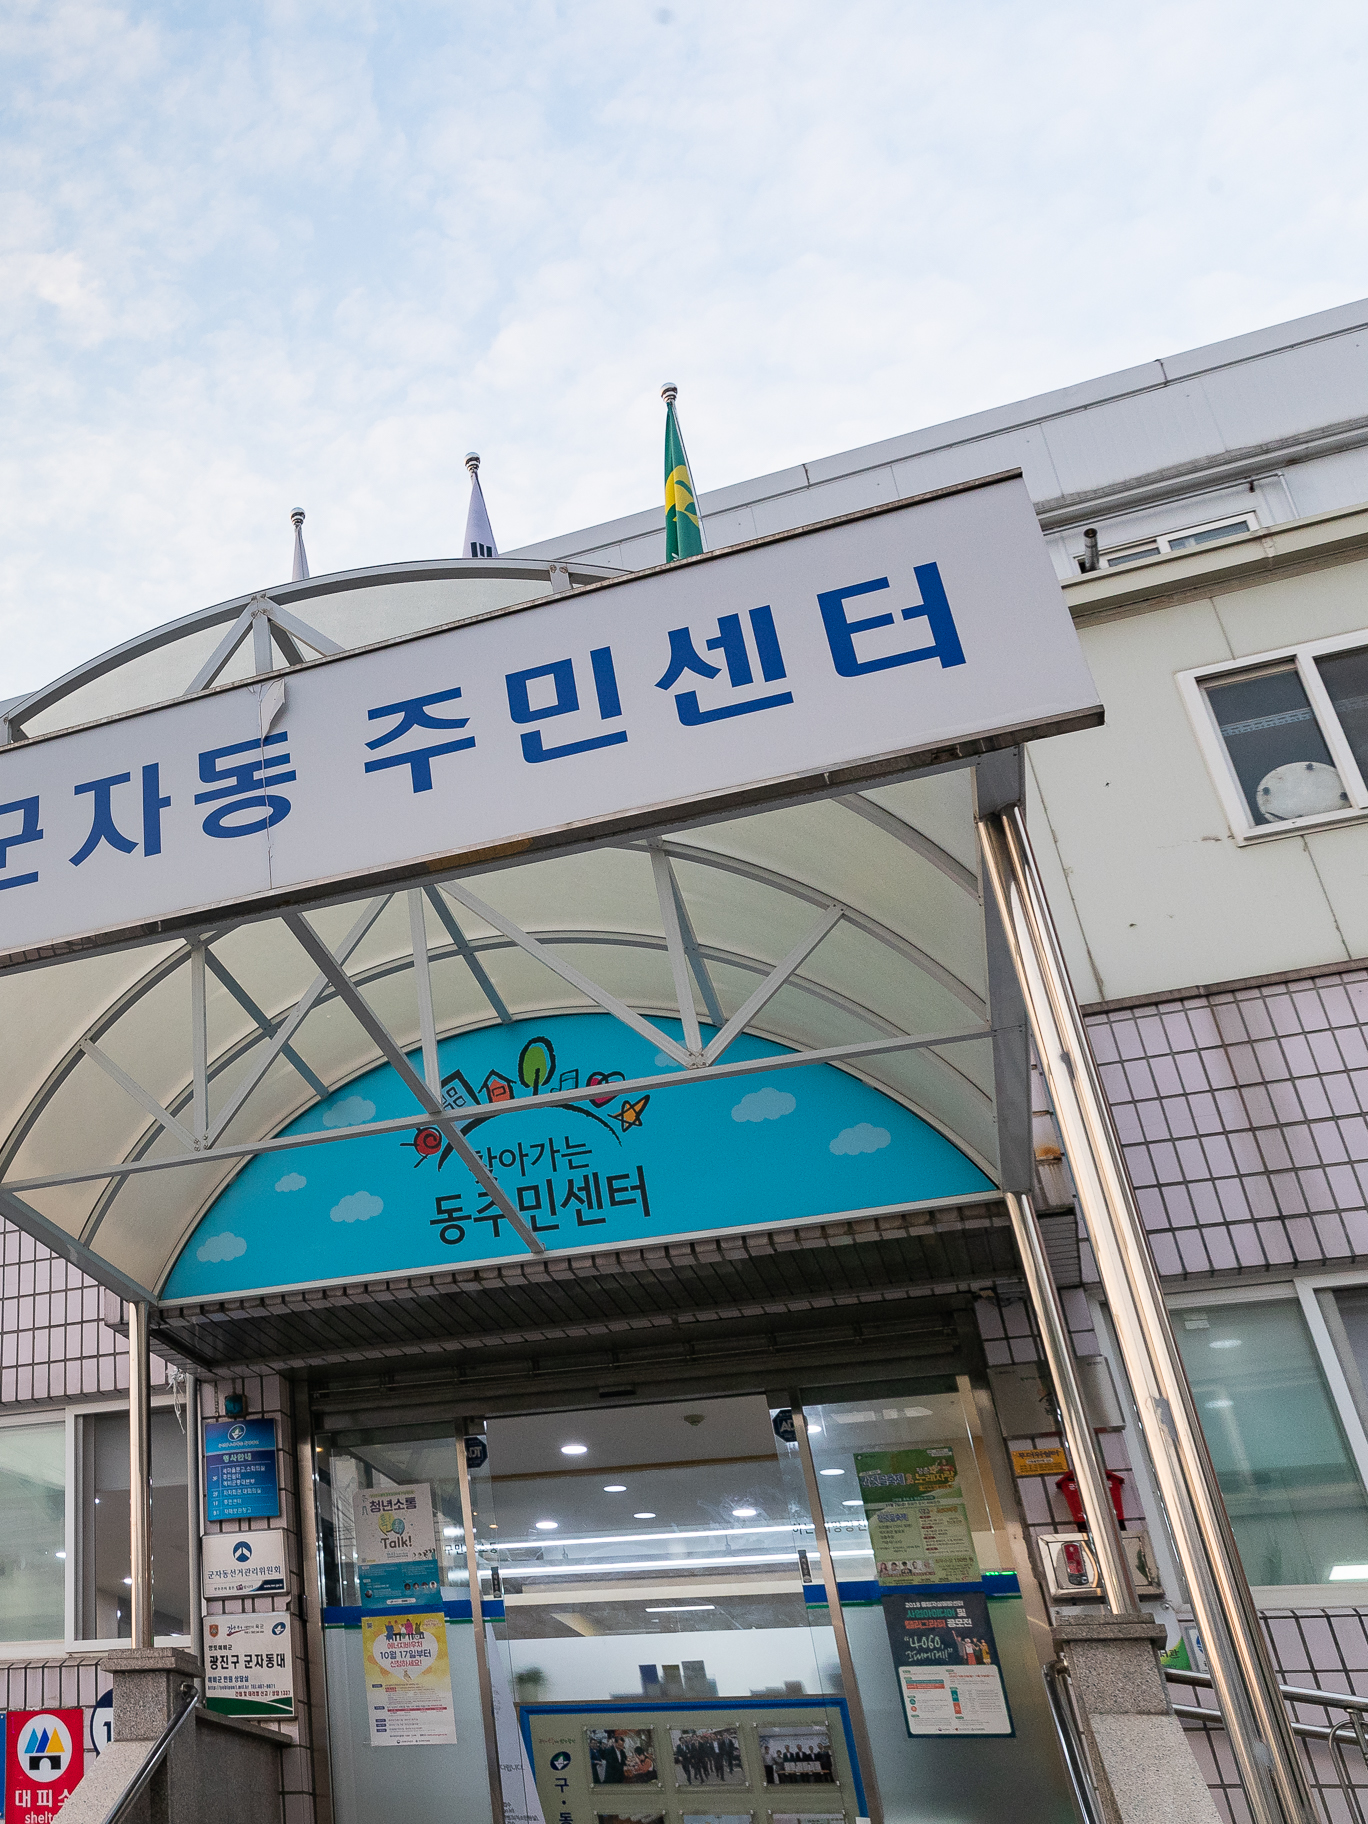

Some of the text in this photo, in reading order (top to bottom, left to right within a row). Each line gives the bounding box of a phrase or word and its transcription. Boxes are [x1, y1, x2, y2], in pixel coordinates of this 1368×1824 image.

[364, 561, 967, 794] 주민센터
[369, 1496, 417, 1513] 청년소통
[380, 1535, 413, 1549] Talk!
[207, 1565, 281, 1579] 군자동선거관리위원회
[946, 1618, 973, 1628] 공모전
[209, 1653, 286, 1670] 광진구 군자동대
[379, 1649, 432, 1660] 10월 17일부터
[389, 1659, 422, 1668] 신청하세요!
